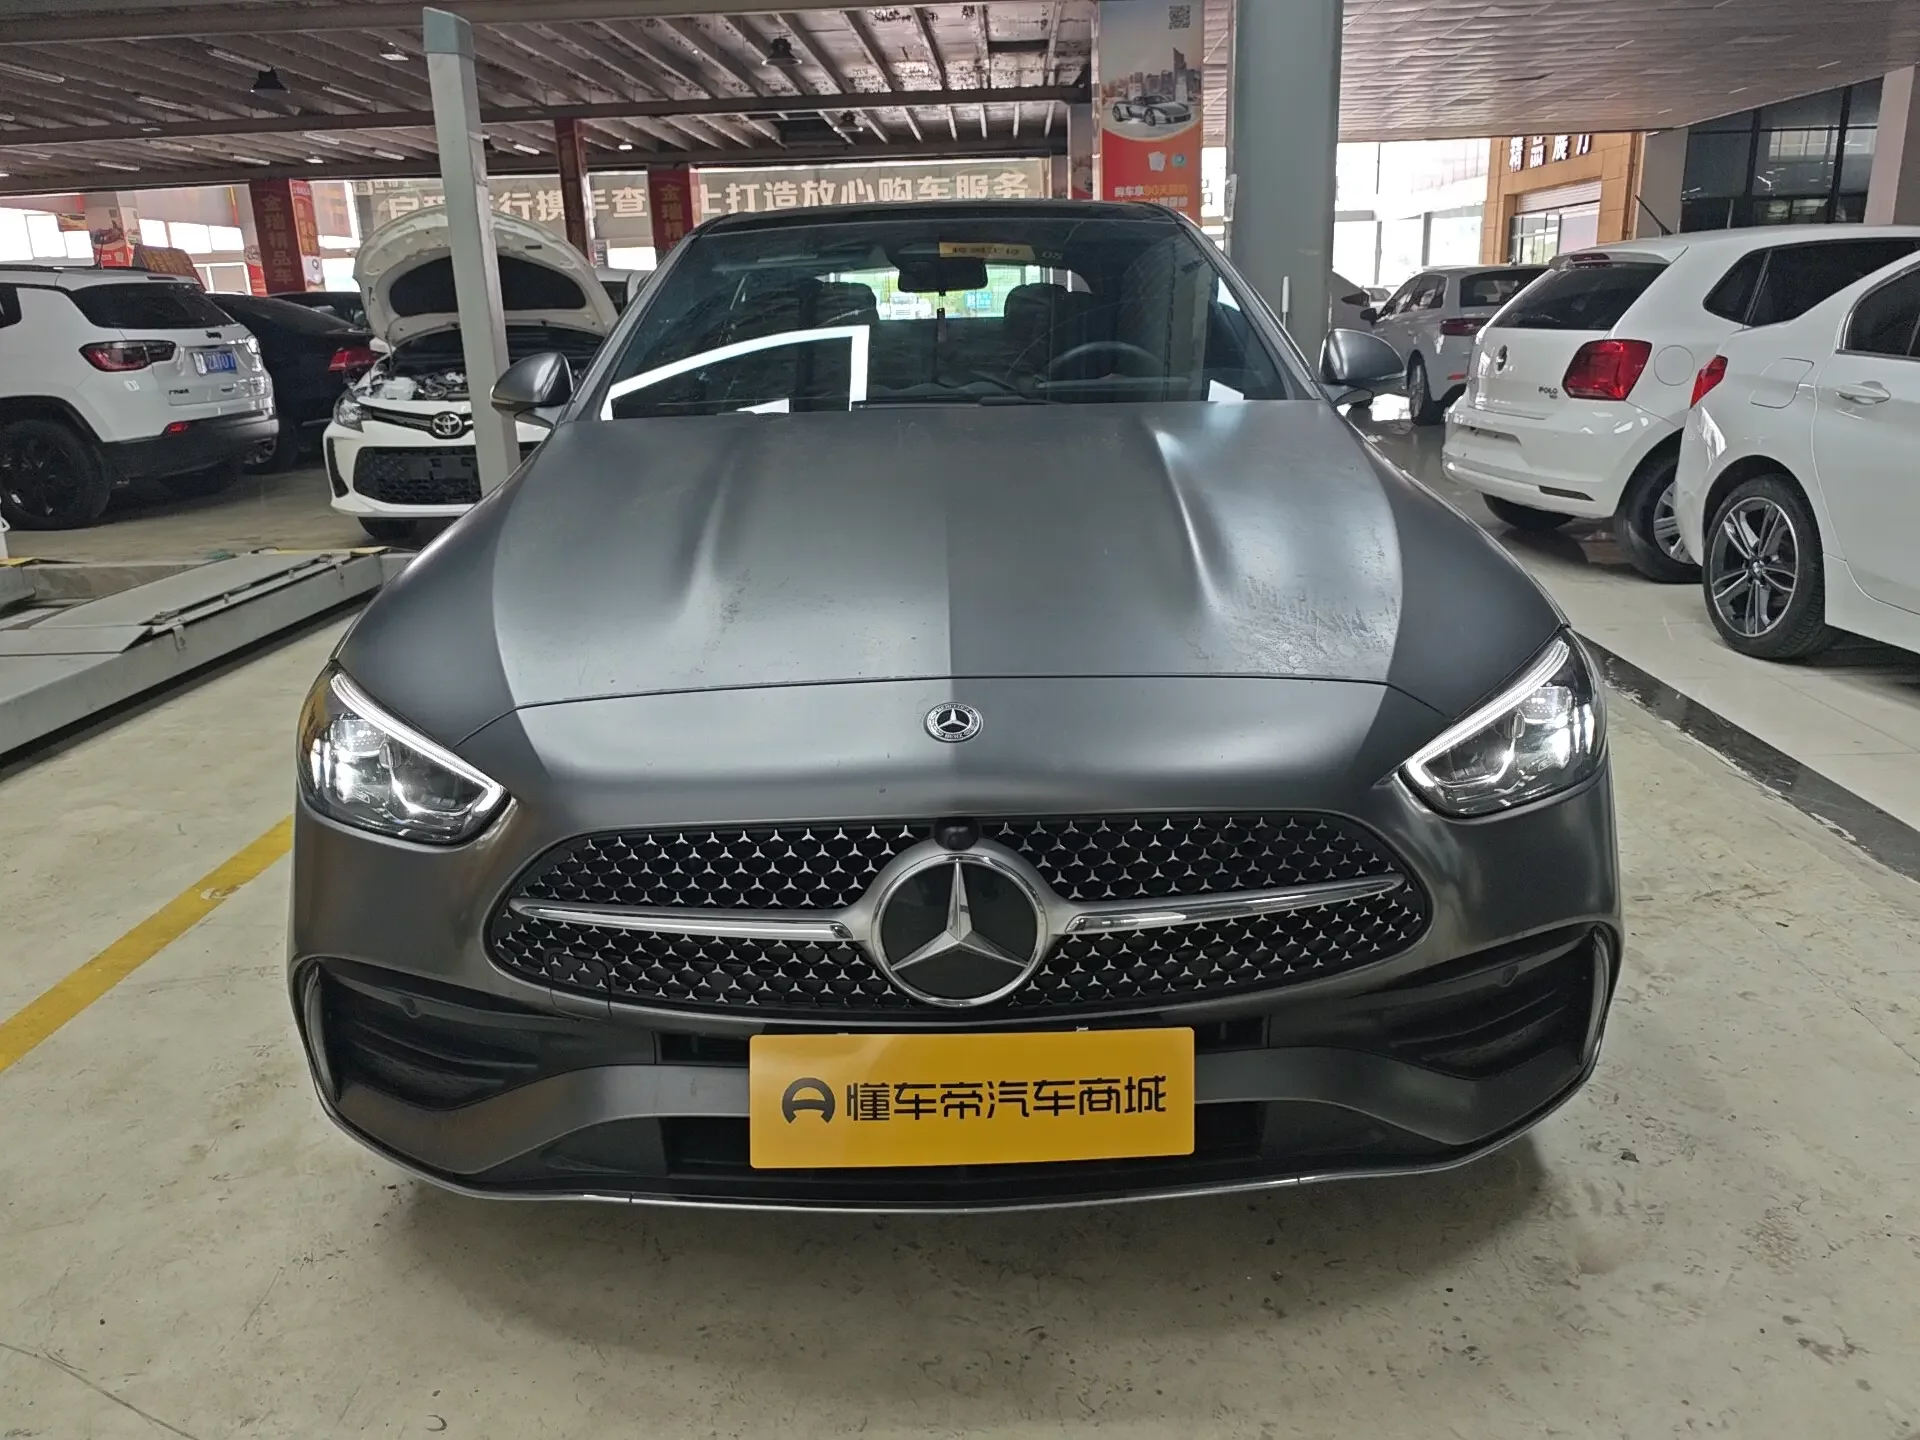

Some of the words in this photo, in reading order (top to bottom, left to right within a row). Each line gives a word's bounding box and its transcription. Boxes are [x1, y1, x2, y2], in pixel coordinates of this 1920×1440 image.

[1538, 386, 1558, 395] POLO
[846, 1076, 1167, 1121] 懂车帝汽车商城
